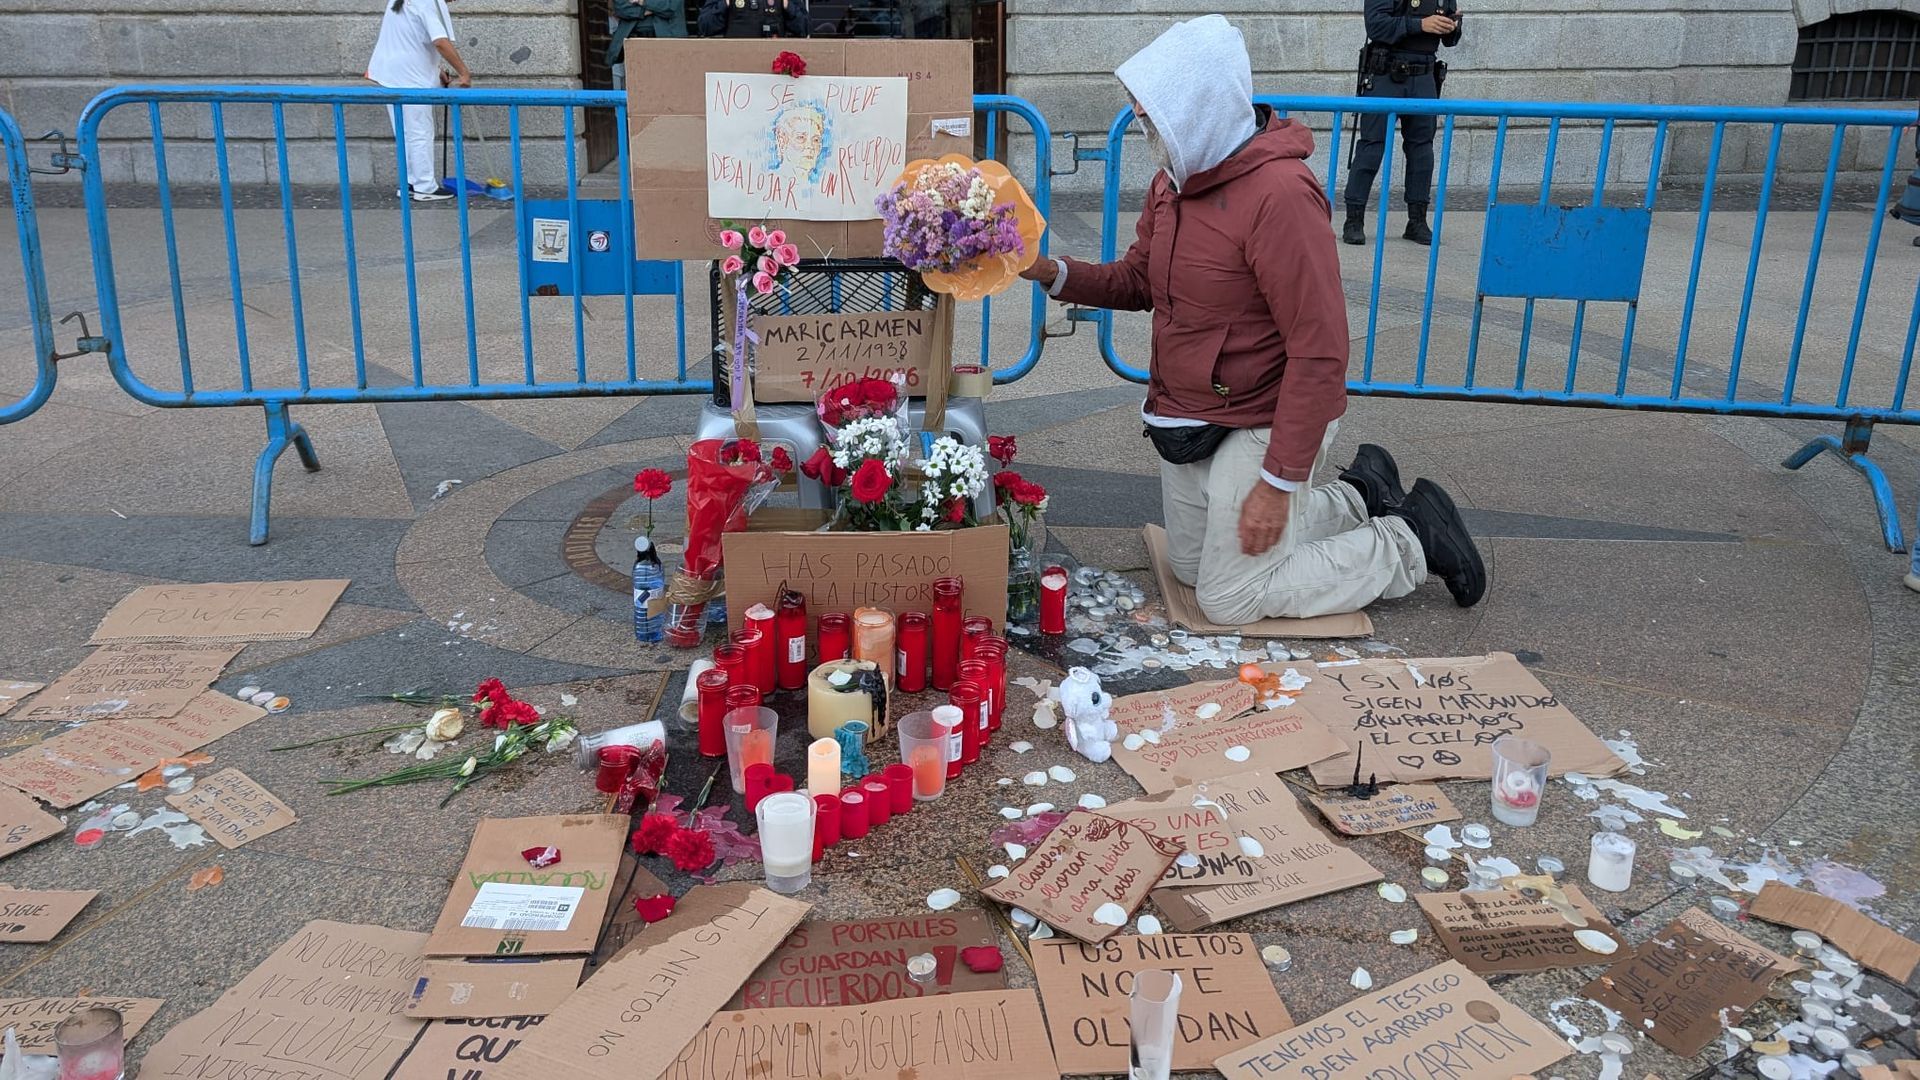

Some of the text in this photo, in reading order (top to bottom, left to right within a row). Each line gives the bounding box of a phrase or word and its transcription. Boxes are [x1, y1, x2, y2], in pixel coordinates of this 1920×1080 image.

[714, 80, 883, 116] NO SE PUEDE
[712, 152, 797, 210] DESALOJAR
[820, 171, 838, 198] UN
[764, 317, 922, 346] MARICARMEN
[799, 366, 920, 389] 7/10/206
[761, 552, 952, 584] HAS PASADO
[156, 587, 309, 602] REST IN
[811, 581, 839, 607] LA
[132, 606, 283, 626] POWER
[1323, 672, 1351, 692] Y
[1361, 674, 1401, 691] SI
[1343, 693, 1559, 711] SIGEN MATANDO
[1182, 741, 1219, 759] DEP
[1369, 729, 1513, 747] EL CIELO
[200, 783, 224, 799] SER
[214, 772, 279, 818] GRACIAS POR
[1248, 786, 1271, 806] EN
[185, 794, 249, 842] DE DIGNIDAD
[1060, 823, 1083, 841] te
[1168, 809, 1219, 831] UNA
[1259, 823, 1288, 841] DE
[1198, 830, 1230, 851] ES
[1040, 848, 1093, 900] lloran
[1266, 853, 1291, 869] TUS
[1072, 877, 1103, 913] alma
[1094, 839, 1134, 876] habita
[1101, 867, 1141, 903] todas
[1216, 884, 1261, 906] LUCHA
[1262, 871, 1307, 893] SIGUE
[1444, 912, 1468, 923] QUE
[1493, 899, 1509, 910] LA
[695, 904, 768, 945] TUS
[832, 918, 958, 947] PORTALES
[287, 931, 325, 963] NO
[1136, 934, 1244, 962] NIETOS
[1463, 943, 1489, 953] QUE
[1480, 944, 1579, 963] CAMINO
[780, 947, 910, 976] GUARDAN
[249, 973, 294, 1000] NI
[621, 949, 700, 1023] NIETOS
[1642, 990, 1678, 1020] SEA
[201, 1006, 285, 1048] NI
[1239, 973, 1461, 1078] TENEMOS EL TESTIGO
[456, 1034, 522, 1063] QU
[587, 1029, 624, 1058] NO
[1301, 1001, 1454, 1080] BIEN AGARRADO
